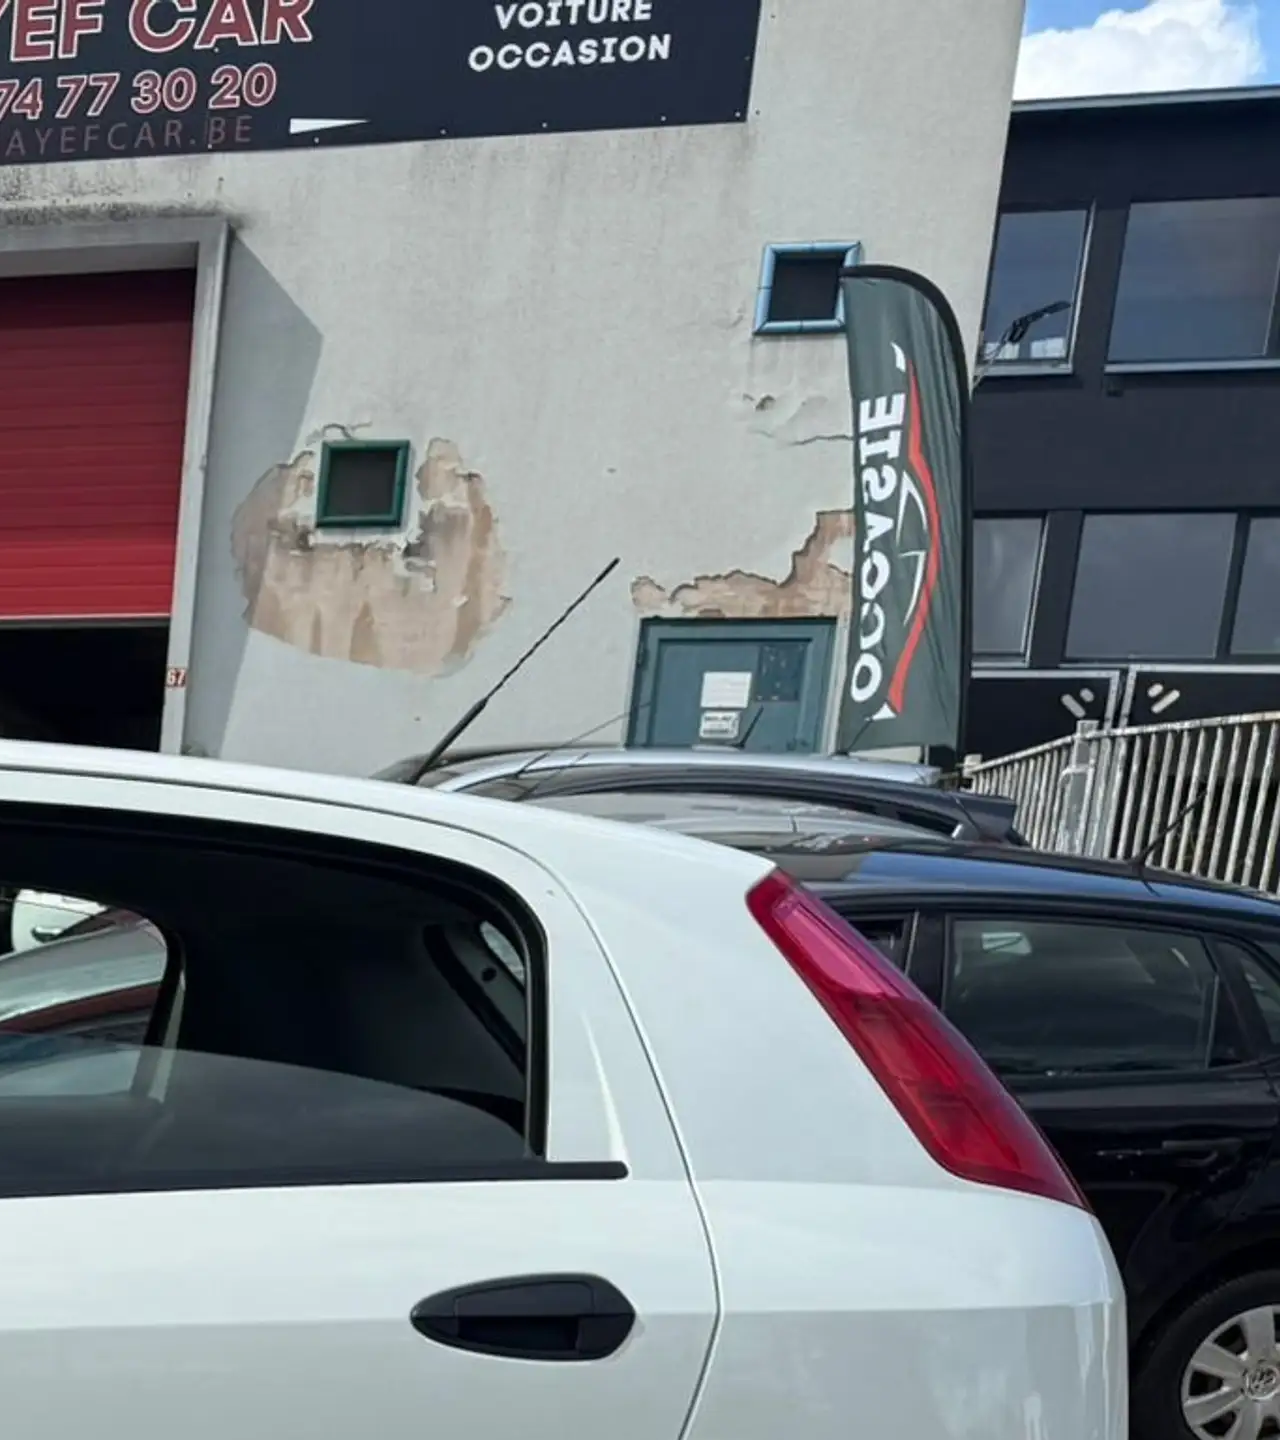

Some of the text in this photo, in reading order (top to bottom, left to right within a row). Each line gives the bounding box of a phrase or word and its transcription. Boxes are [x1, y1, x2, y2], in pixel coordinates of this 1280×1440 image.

[128, 0, 313, 53] CAR
[494, 0, 653, 30] VOITURE
[468, 33, 672, 72] OCCASION
[54, 72, 121, 120] 77
[130, 66, 198, 115] 30
[208, 61, 278, 109] 20
